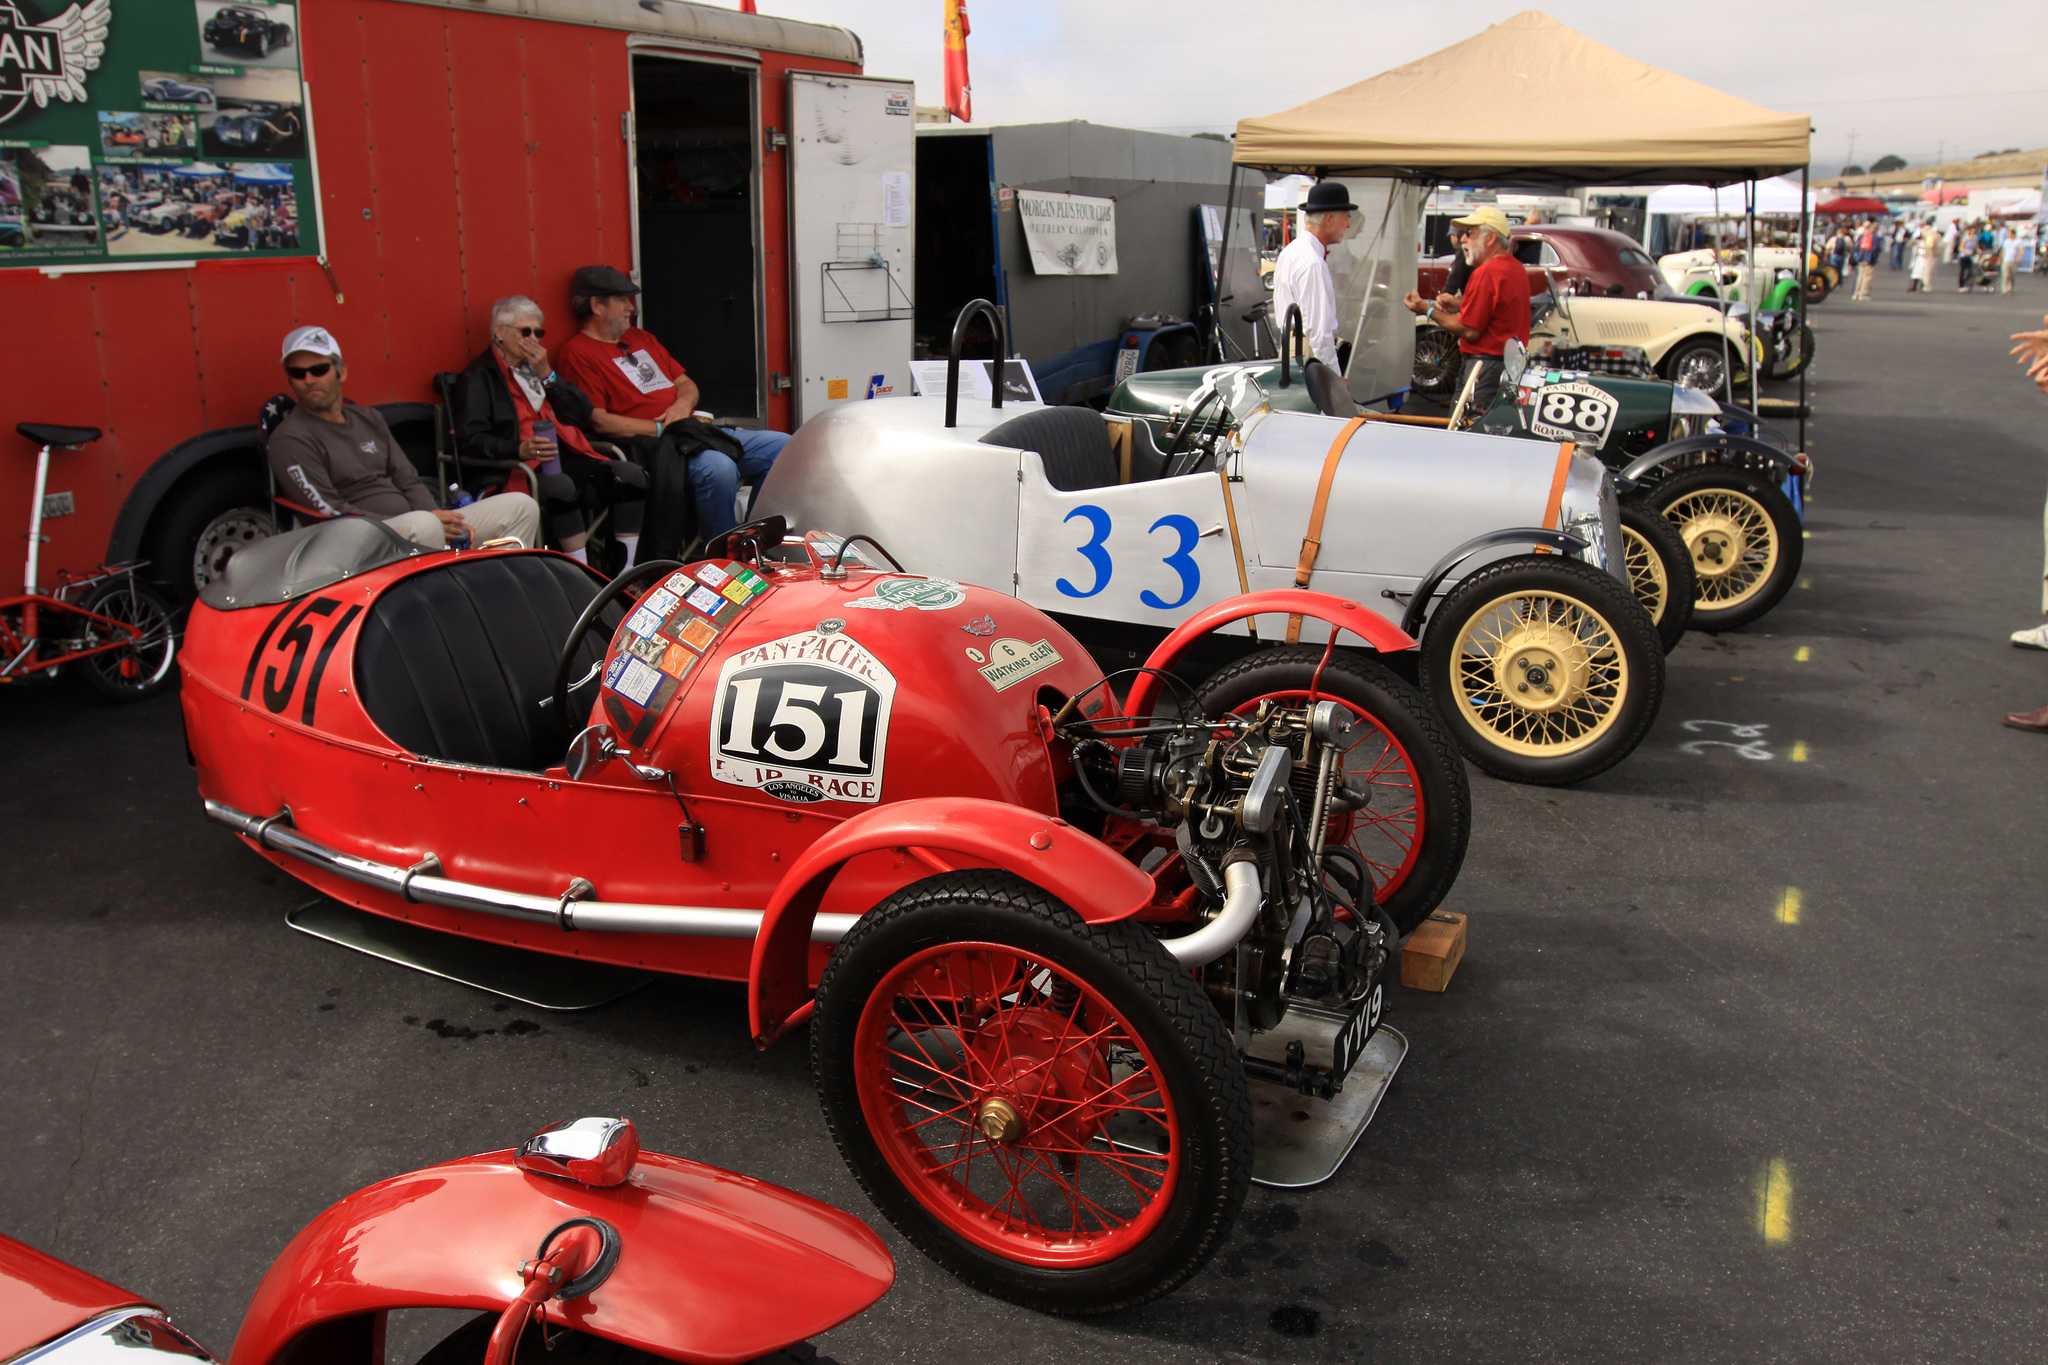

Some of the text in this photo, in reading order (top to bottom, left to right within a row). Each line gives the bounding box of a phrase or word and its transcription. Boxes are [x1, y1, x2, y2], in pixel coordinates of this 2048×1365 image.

[1021, 199, 1056, 217] MORGAN
[1056, 201, 1075, 218] PLUS
[1076, 203, 1095, 220] FOUR
[1027, 223, 1065, 235] OUTHERN
[875, 386, 893, 397] pace
[1543, 393, 1608, 432] 88
[886, 581, 947, 603] MORGAN
[241, 594, 364, 727] 151
[969, 649, 983, 661] 1
[1001, 644, 1016, 656] 6
[983, 657, 1032, 682] WATKINS
[1029, 642, 1054, 662] GLEN
[722, 677, 869, 769] 151
[768, 782, 819, 798] LOS ANGELES
[807, 774, 876, 798] RACE
